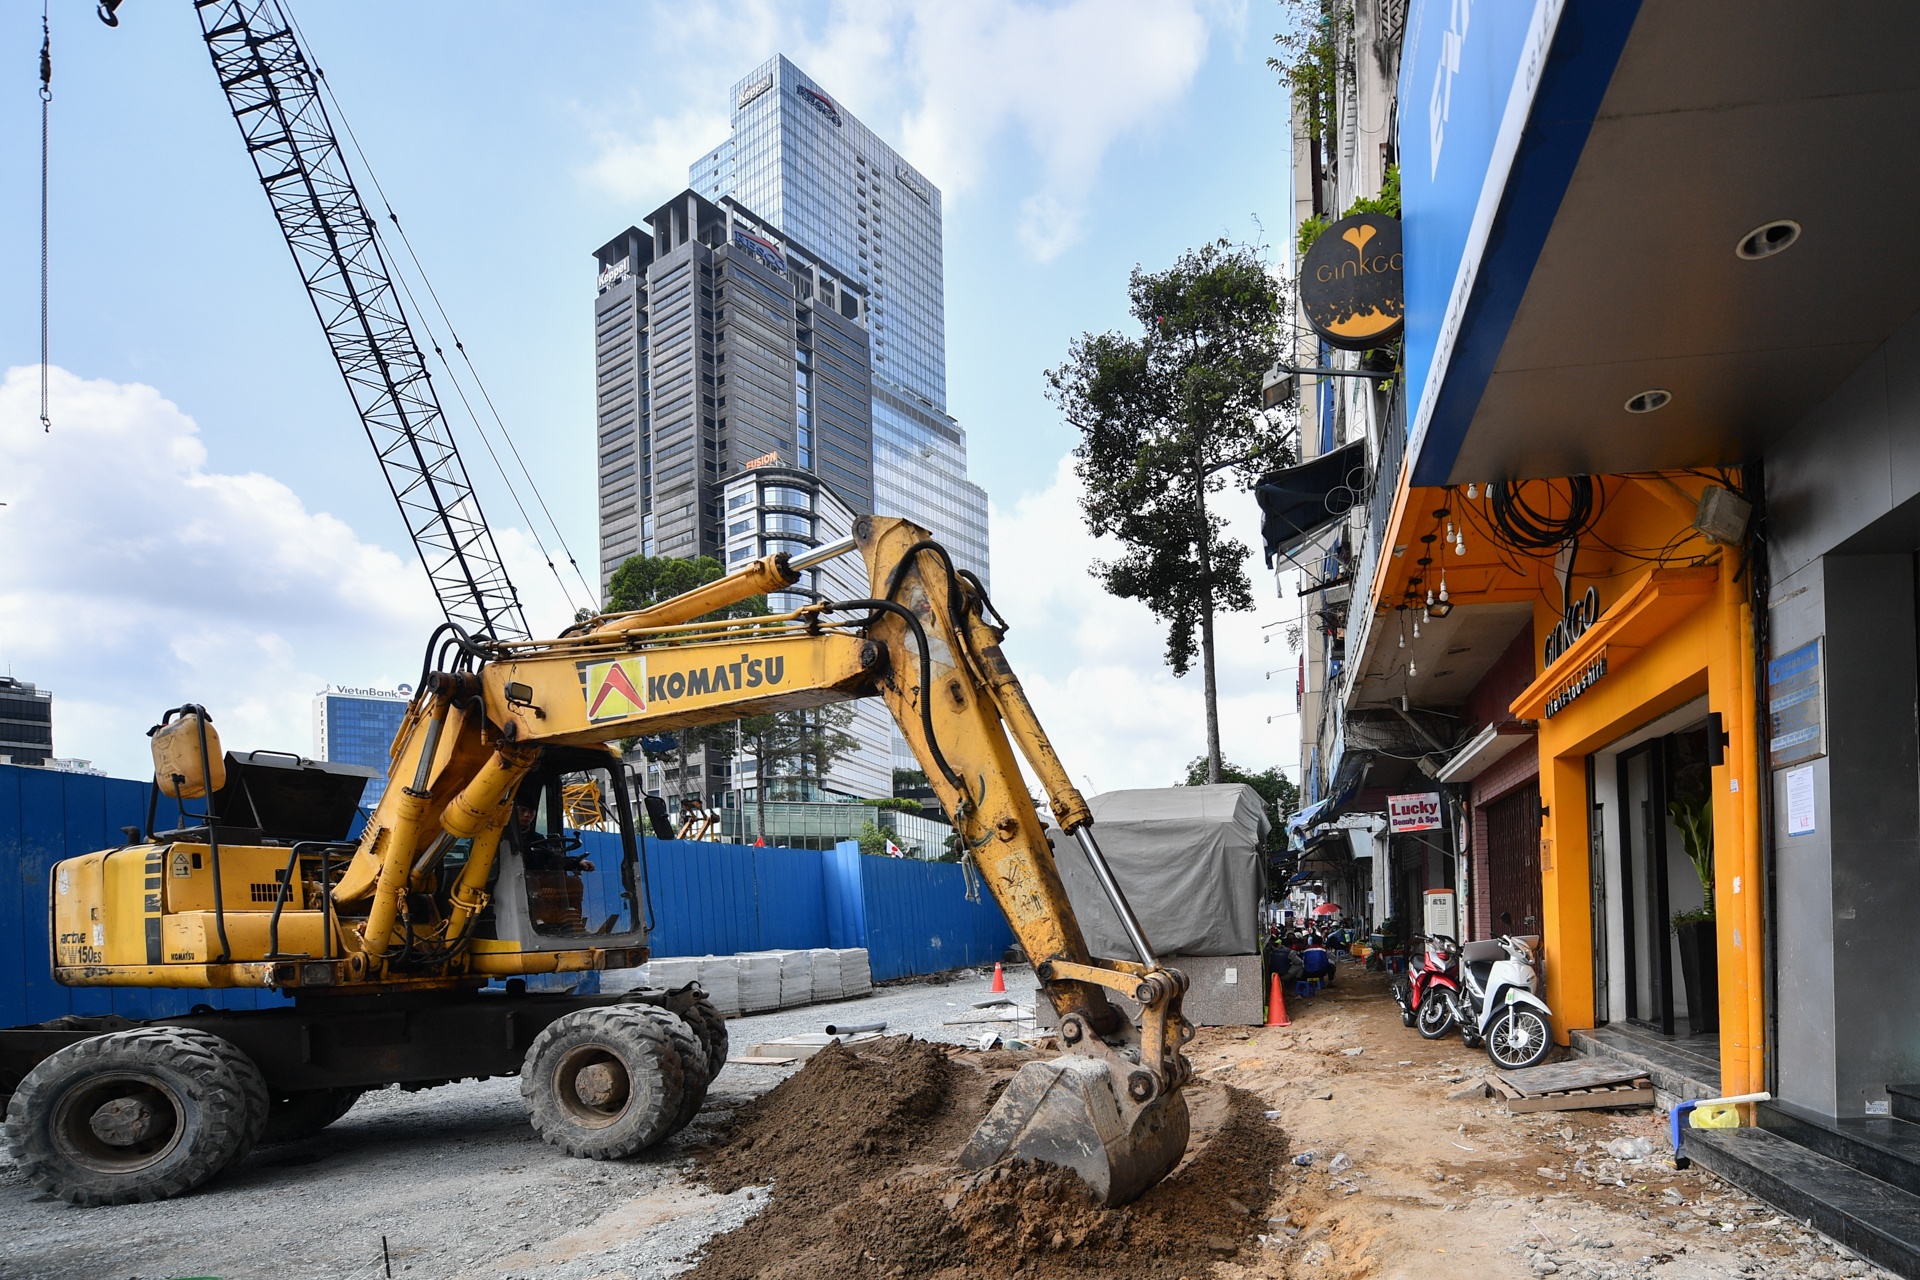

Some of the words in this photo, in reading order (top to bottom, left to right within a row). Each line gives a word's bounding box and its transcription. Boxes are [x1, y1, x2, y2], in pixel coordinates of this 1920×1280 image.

[738, 74, 770, 105] Keppel
[898, 167, 930, 201] Keppel
[734, 231, 786, 272] RESCO
[598, 258, 628, 287] Keppel
[746, 450, 777, 470] FUSION
[648, 653, 785, 702] KOMATSU
[336, 685, 398, 698] VietinBank
[1391, 800, 1438, 816] Lucky
[1392, 817, 1417, 826] Beauty
[1425, 815, 1439, 823] Spa
[170, 950, 195, 961] KOMATSU
